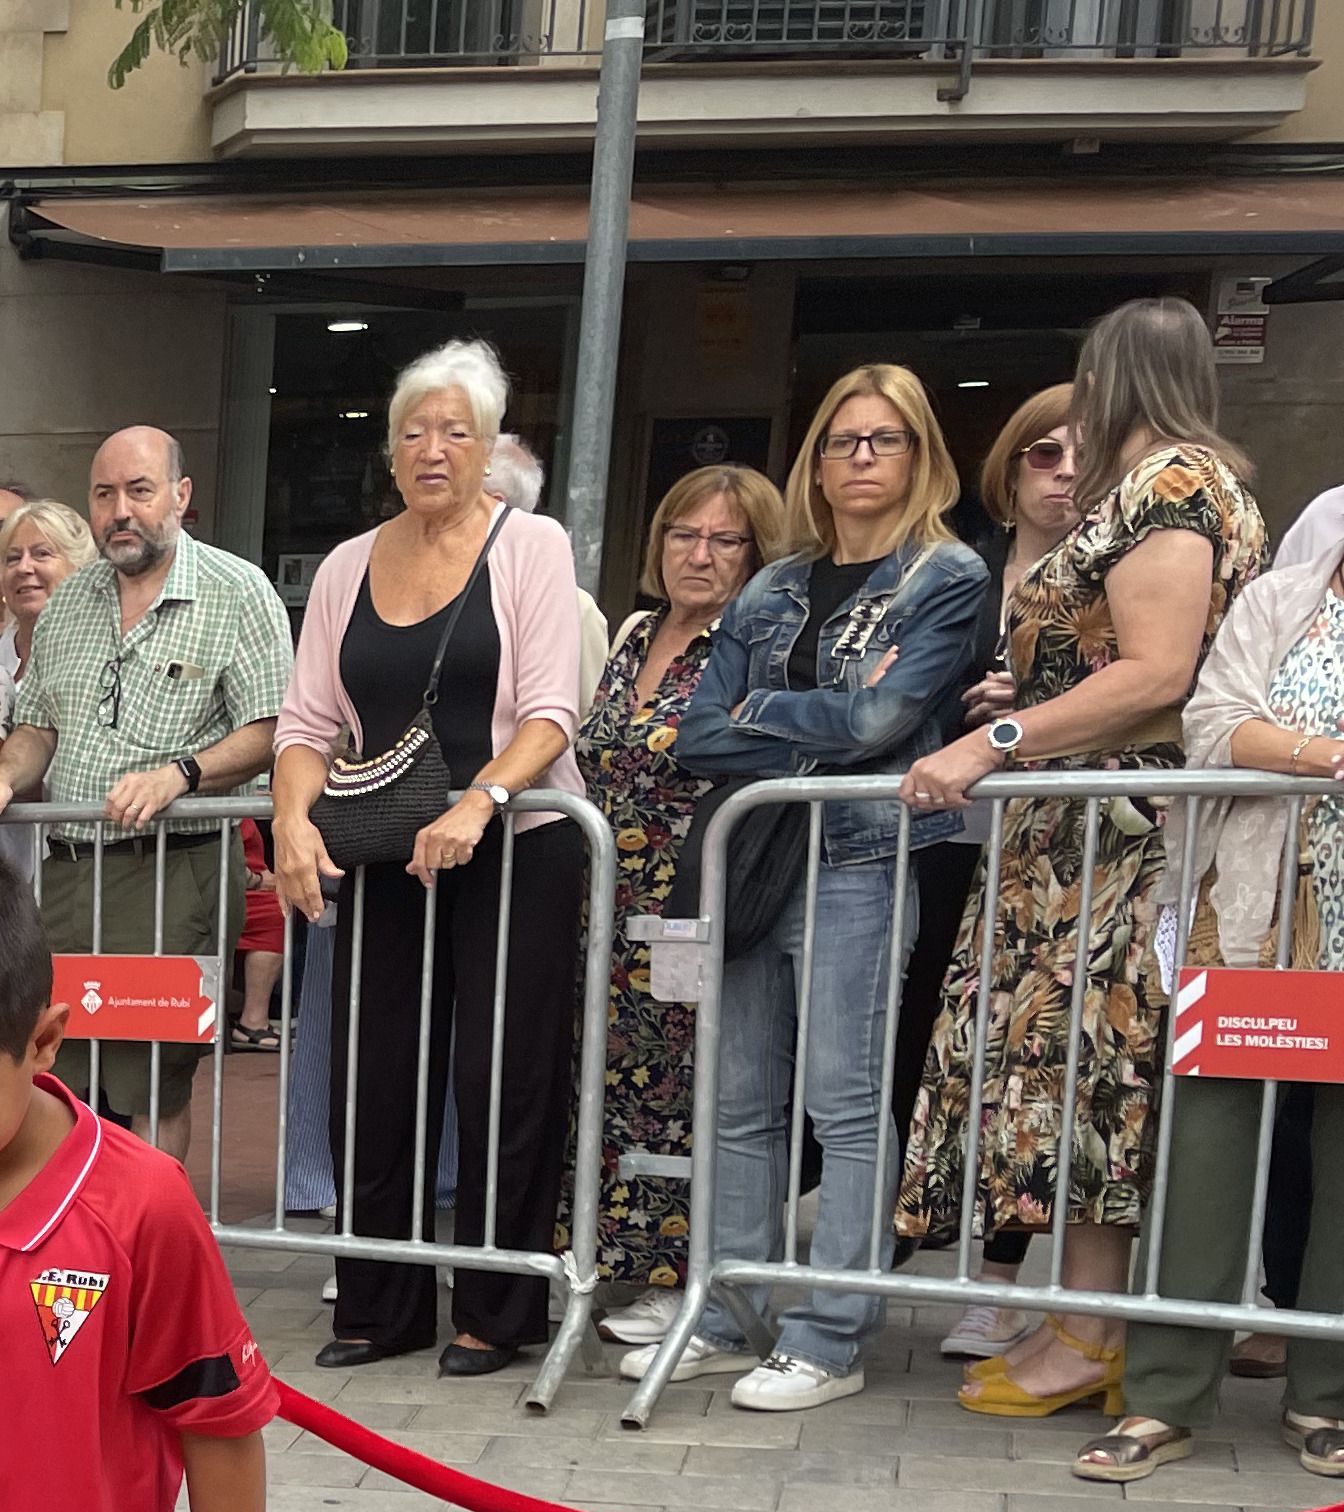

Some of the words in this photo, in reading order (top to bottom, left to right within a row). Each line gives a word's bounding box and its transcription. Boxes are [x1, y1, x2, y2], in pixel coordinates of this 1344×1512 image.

[107, 995, 157, 1008] Ajuntament
[158, 996, 169, 1008] de
[1217, 1016, 1297, 1031] DISCULPEU
[1216, 1033, 1242, 1046] LES
[1245, 1033, 1329, 1050] MOLÈSTIES!
